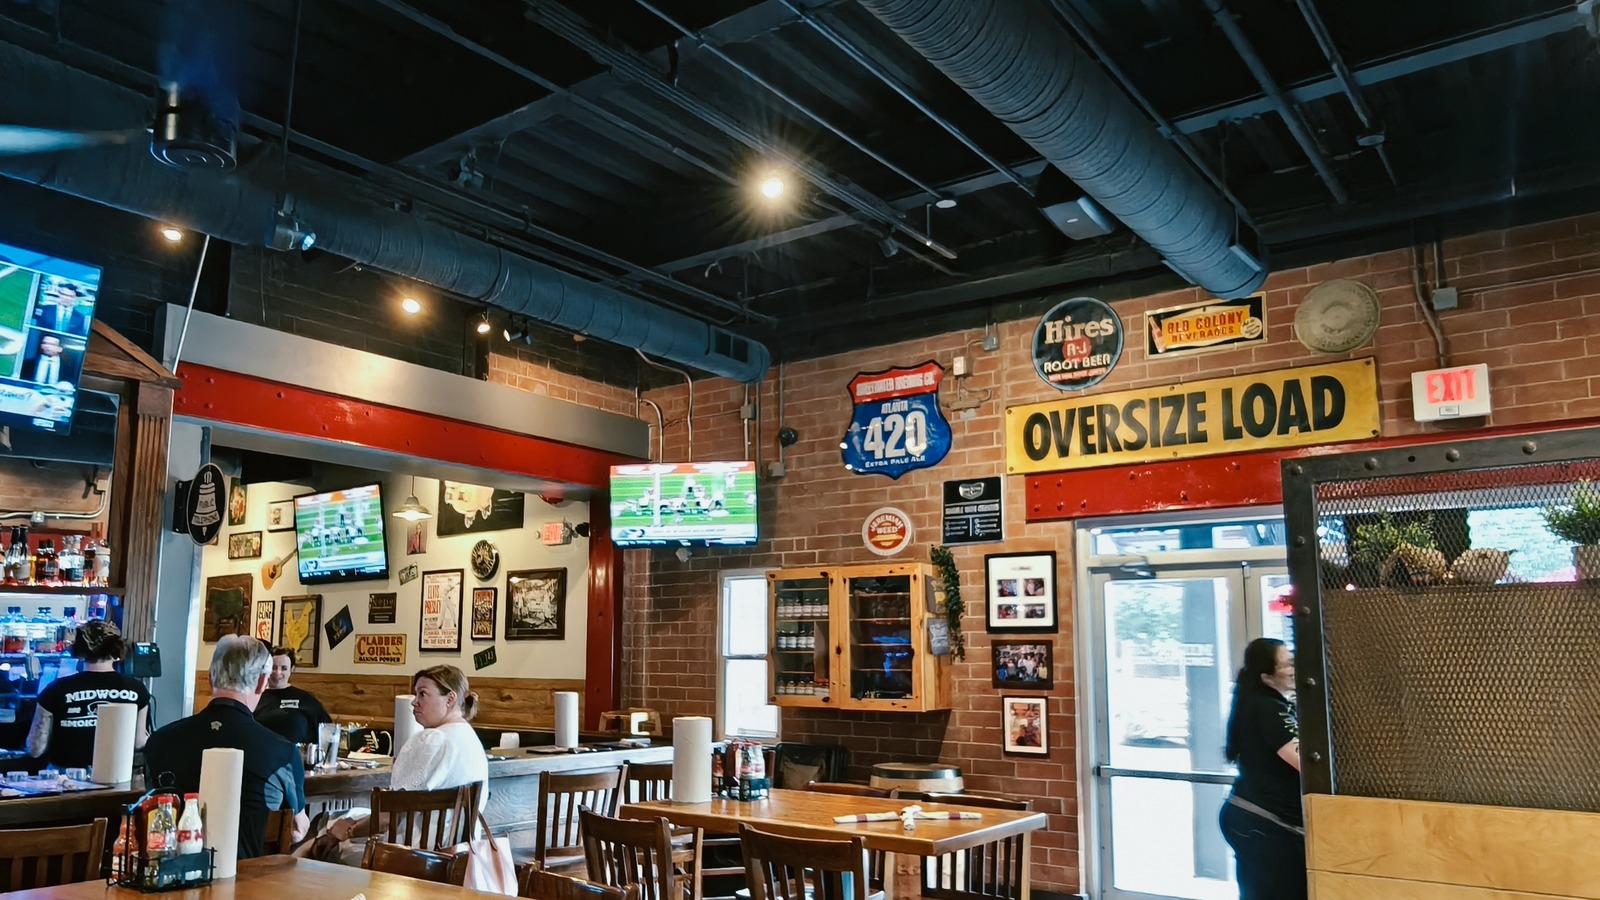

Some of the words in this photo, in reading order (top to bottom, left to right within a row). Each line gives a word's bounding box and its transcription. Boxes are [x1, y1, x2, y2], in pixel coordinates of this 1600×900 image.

[1044, 315, 1114, 344] Hires
[1196, 311, 1243, 329] COLONY
[1172, 326, 1234, 342] BEVERAGES
[1043, 359, 1080, 373] ROOT
[1082, 353, 1111, 367] BEER
[1426, 368, 1476, 404] EXIT
[881, 400, 908, 414] ATLANTA
[1023, 391, 1208, 461] OVERSIZE
[1221, 375, 1346, 441] LOAD
[863, 411, 927, 460] 420
[357, 636, 403, 656] CLABBER
[367, 647, 391, 656] GIRL
[65, 689, 138, 703] MIDWOOD
